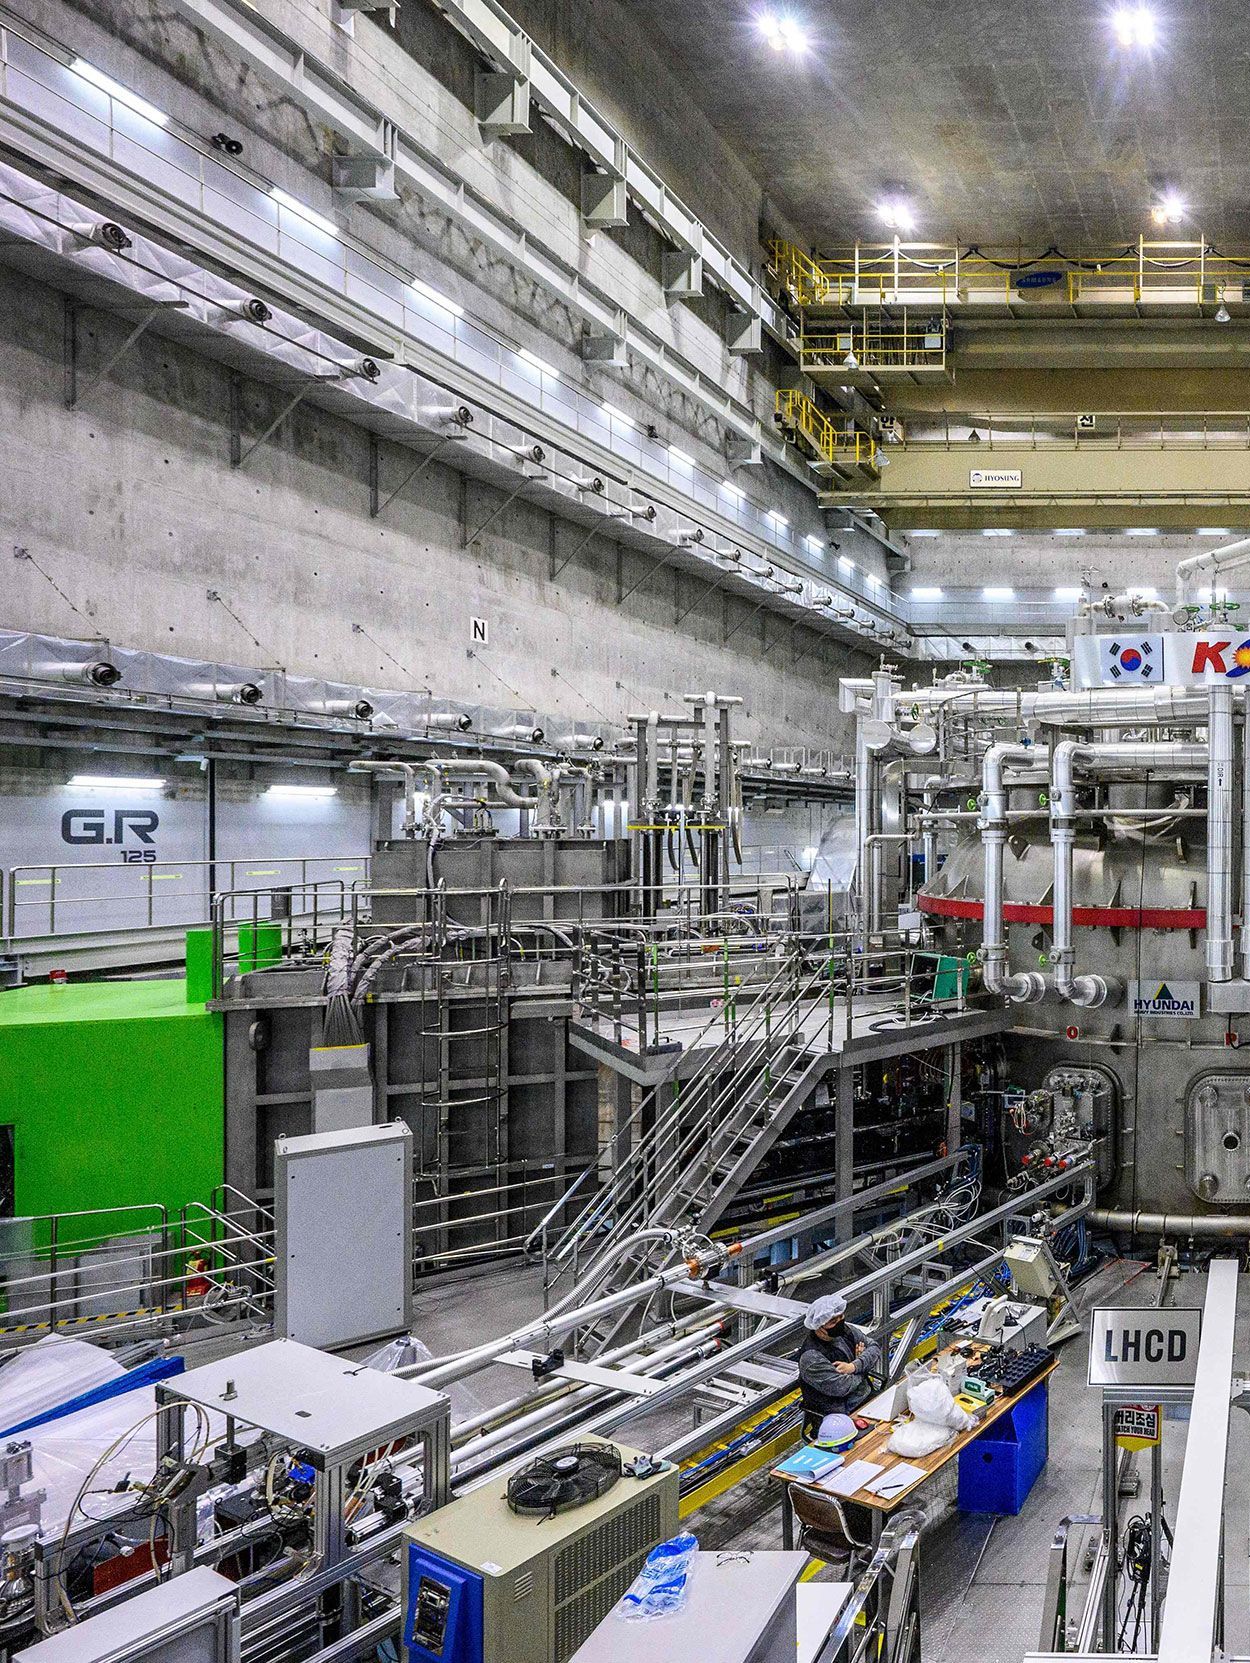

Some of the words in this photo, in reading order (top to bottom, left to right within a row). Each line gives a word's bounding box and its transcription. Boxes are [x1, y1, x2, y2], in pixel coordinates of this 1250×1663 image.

[474, 620, 485, 641] N
[120, 849, 157, 863] 125
[1134, 999, 1194, 1011] HYUNDAI
[1104, 1328, 1187, 1363] LHCD
